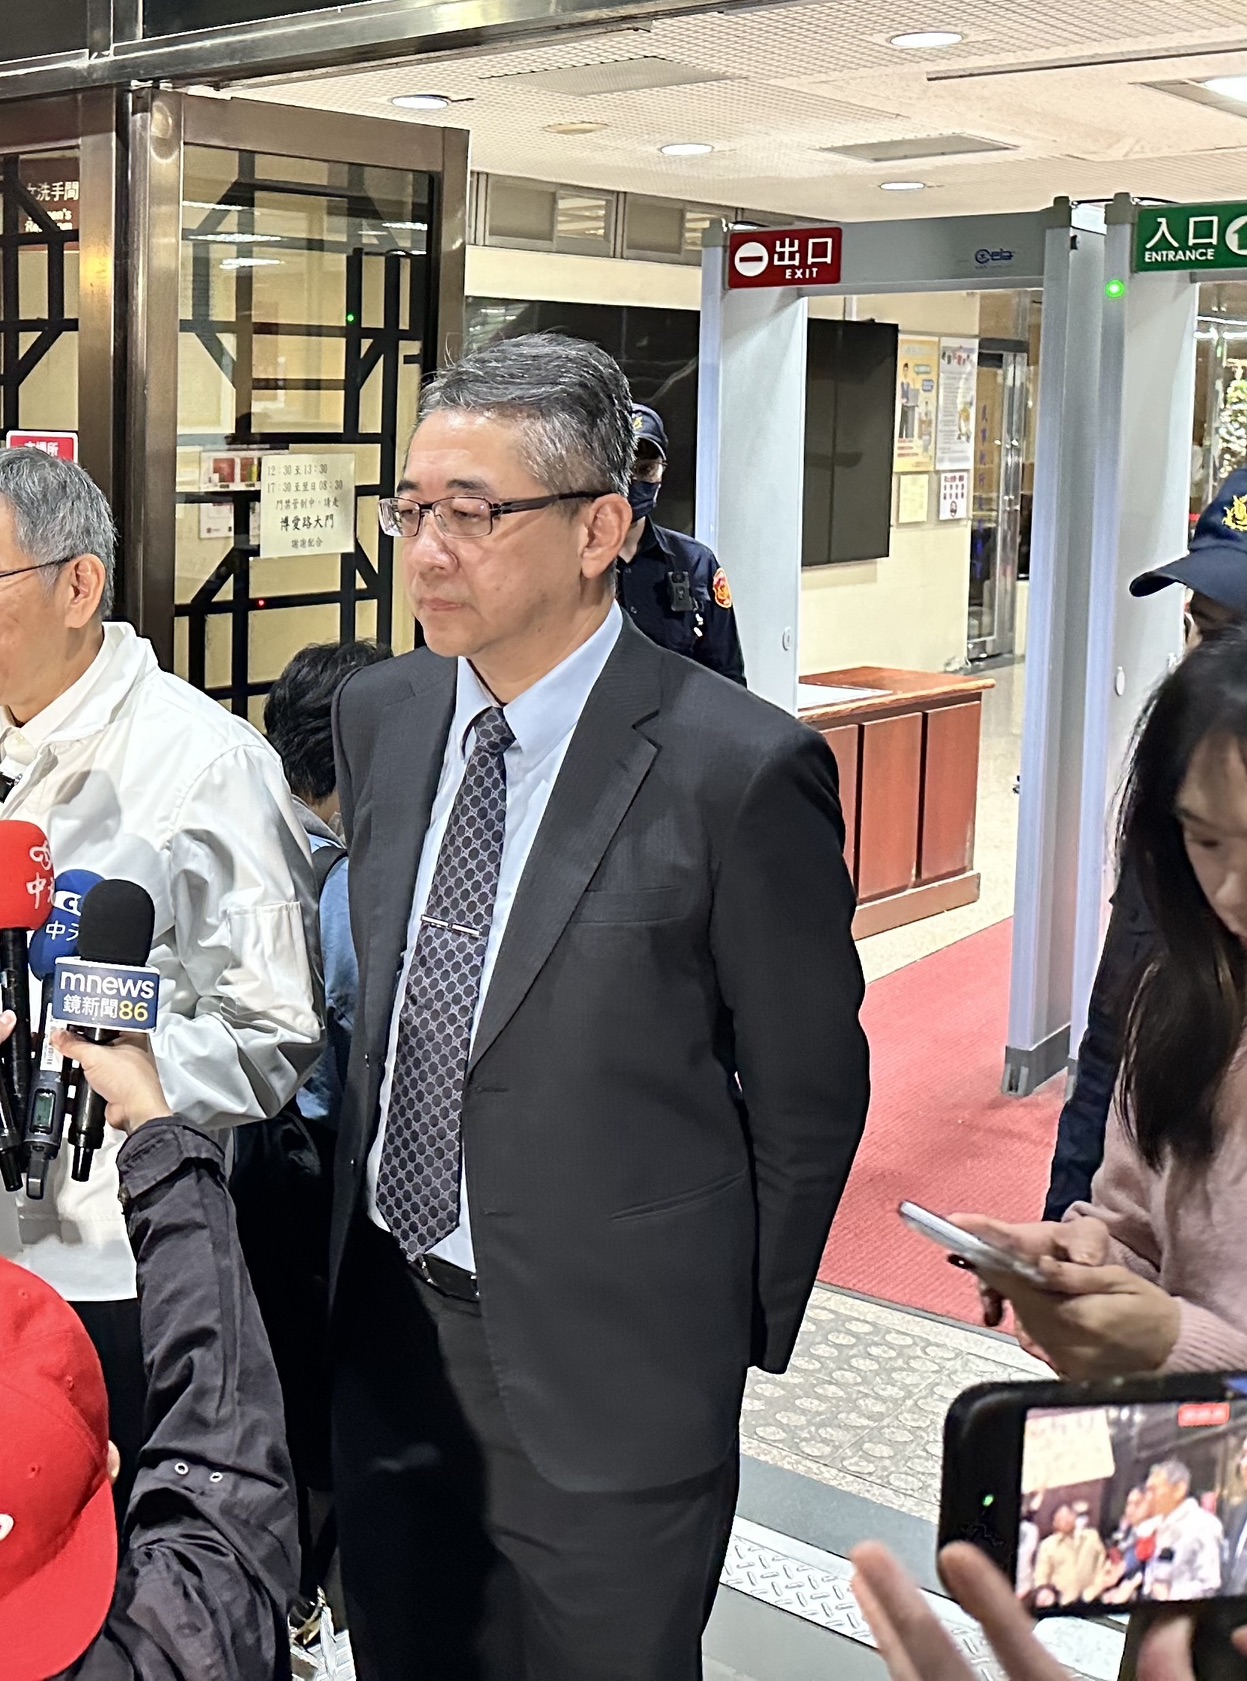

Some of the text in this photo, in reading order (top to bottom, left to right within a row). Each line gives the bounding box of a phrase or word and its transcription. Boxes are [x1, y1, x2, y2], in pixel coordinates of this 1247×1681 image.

[1145, 216, 1218, 248] 入口
[774, 238, 832, 266] 出口
[1144, 249, 1215, 262] ENTRANCE
[785, 267, 818, 279] EXIT
[60, 971, 154, 999] mnews
